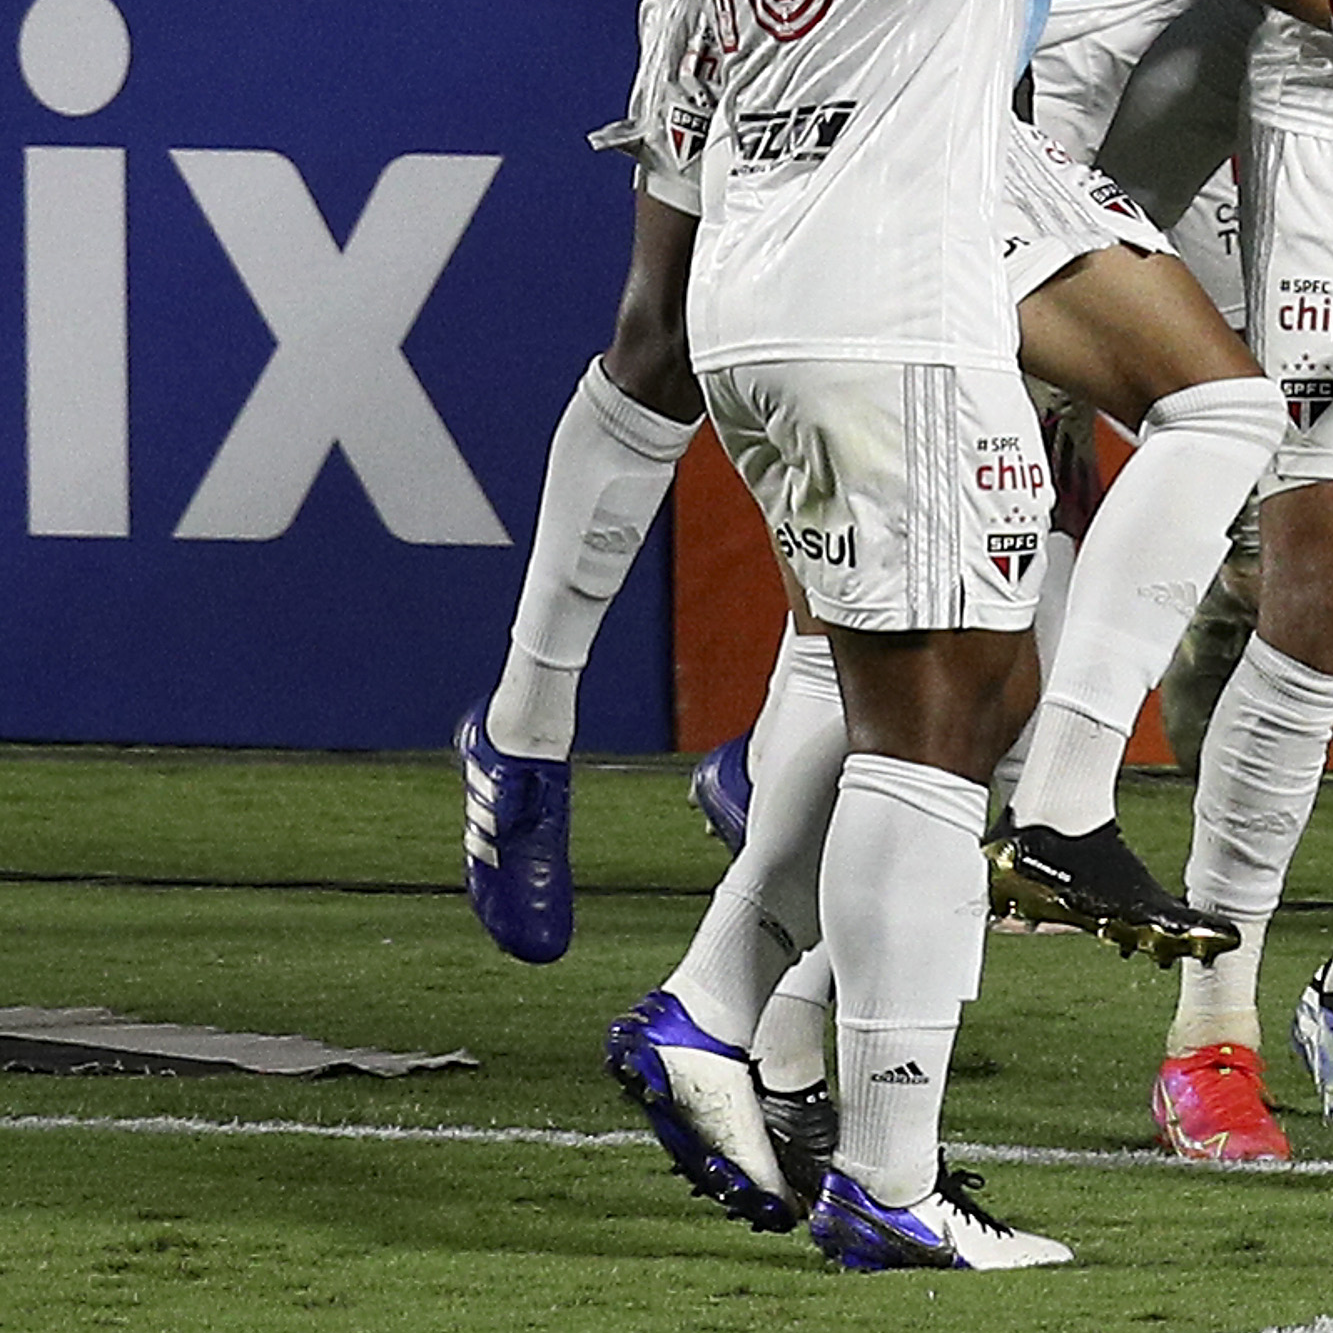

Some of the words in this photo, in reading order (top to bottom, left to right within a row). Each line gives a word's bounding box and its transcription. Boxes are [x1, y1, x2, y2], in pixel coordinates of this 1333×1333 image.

[1283, 383, 1331, 396] SPFC
[975, 454, 1045, 500] chip
[990, 535, 1036, 551] SPFC
